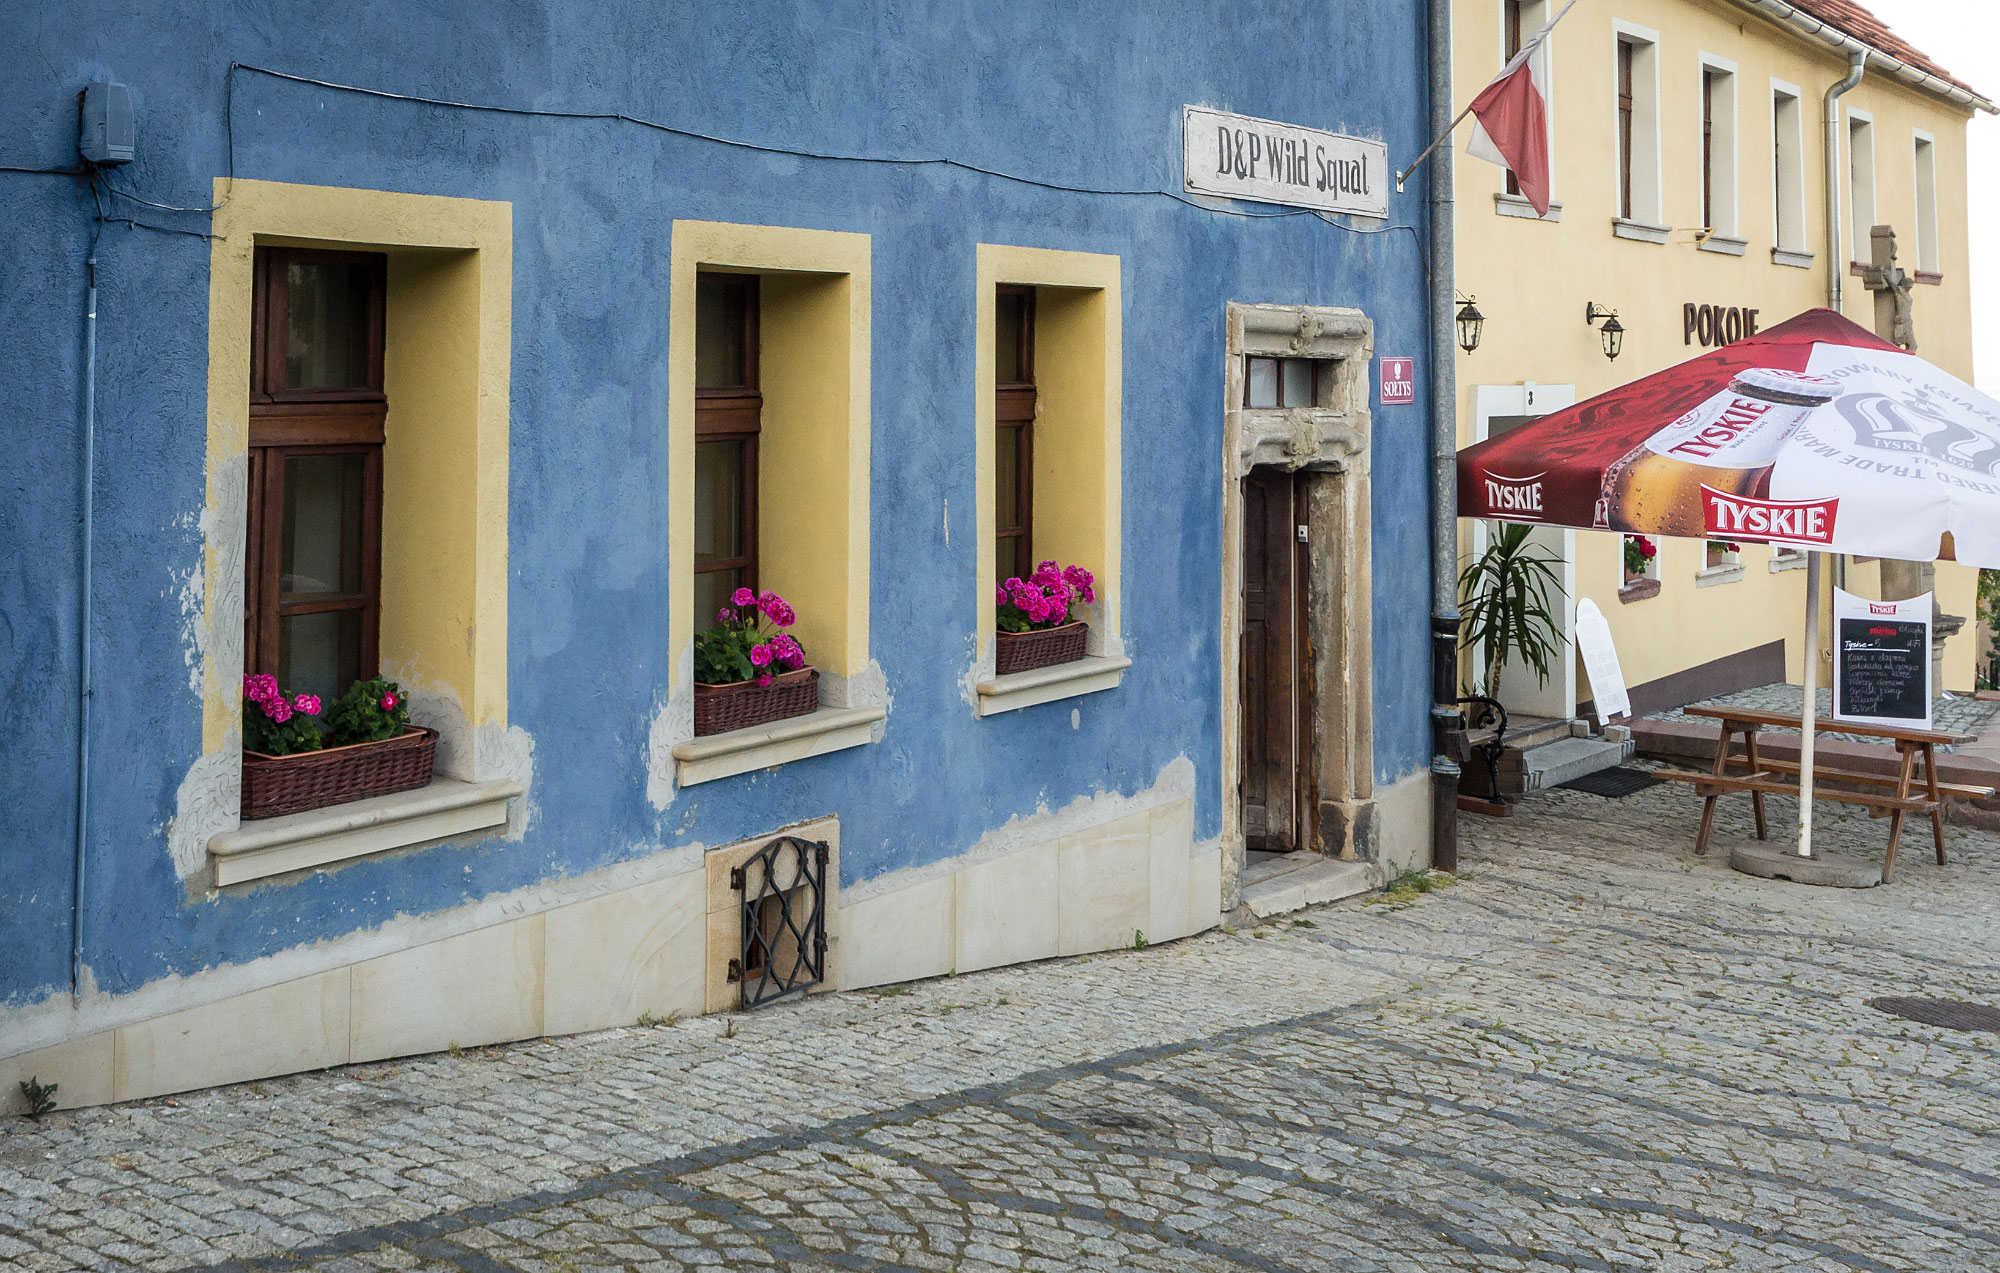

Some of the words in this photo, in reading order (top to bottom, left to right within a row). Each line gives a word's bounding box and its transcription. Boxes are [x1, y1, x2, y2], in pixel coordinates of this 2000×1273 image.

[1216, 126, 1261, 180] D&P
[1265, 135, 1309, 188] Wild
[1316, 151, 1370, 200] Squat
[1820, 362, 1913, 384] ROWARY
[1528, 391, 1533, 405] 3
[1667, 398, 1775, 458] TYSKIE
[1838, 454, 1926, 480] TRADE
[1485, 479, 1543, 512] TYSKIE
[1711, 497, 1828, 540] TYSKIE
[1871, 605, 1895, 614] TYSKIE
